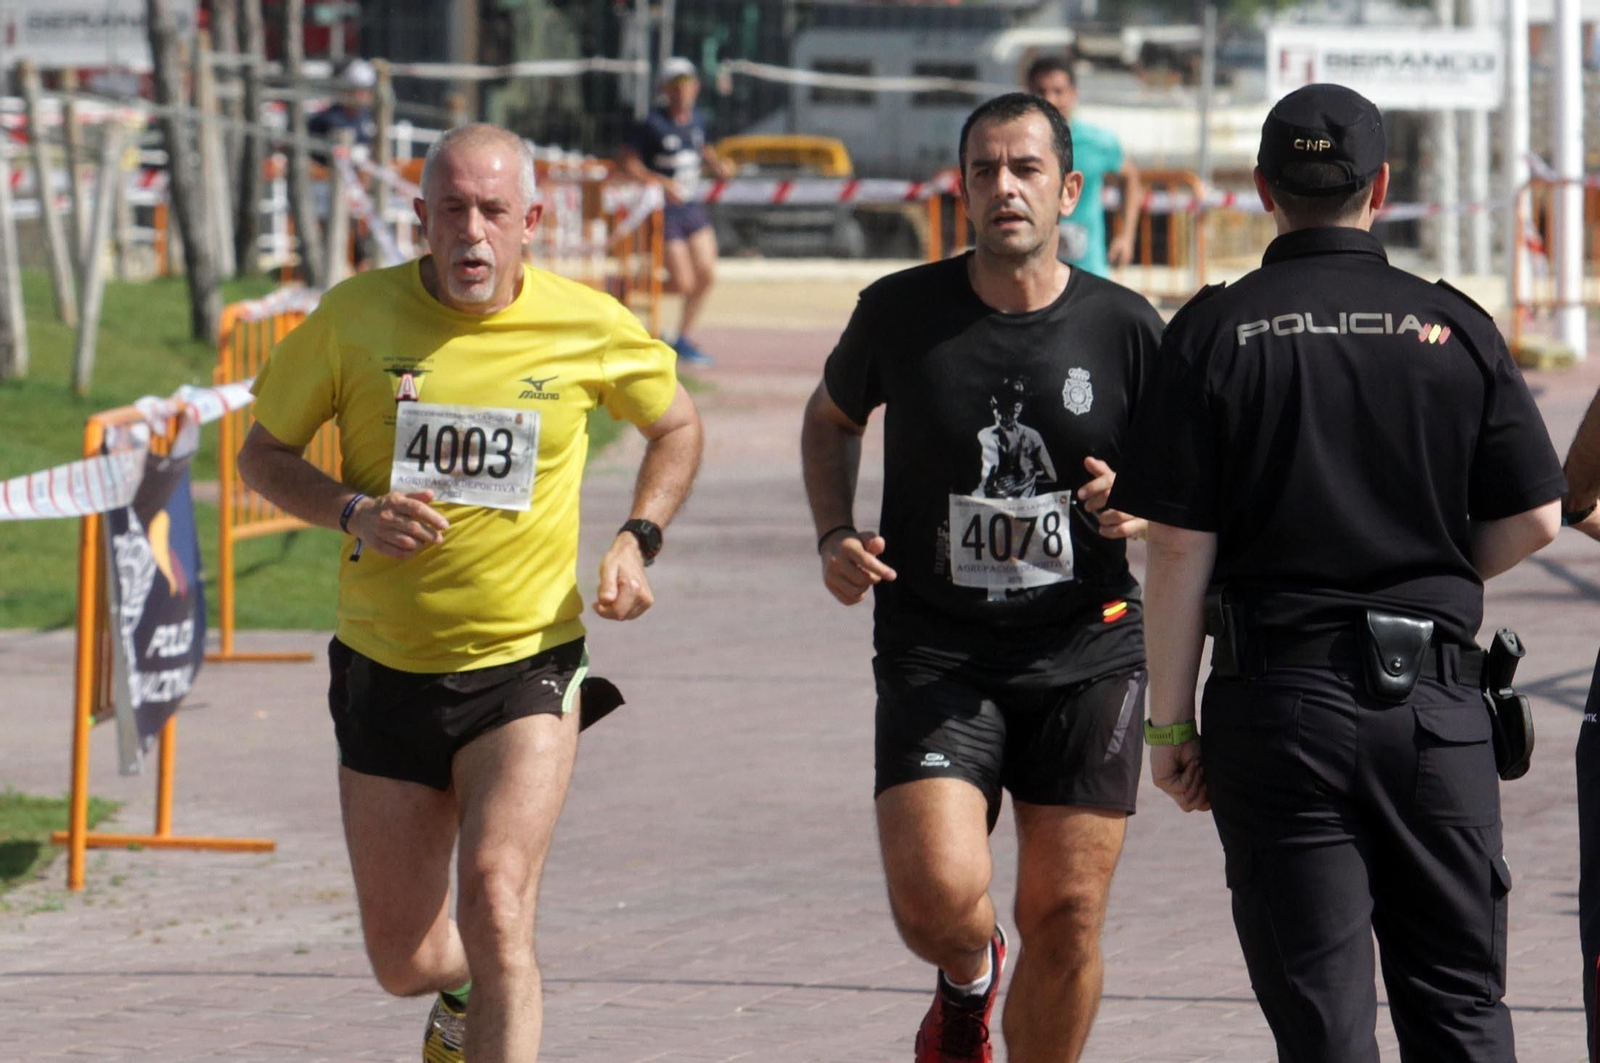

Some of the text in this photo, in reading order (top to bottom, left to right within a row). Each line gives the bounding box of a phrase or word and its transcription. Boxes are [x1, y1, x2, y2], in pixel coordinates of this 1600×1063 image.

[1293, 137, 1332, 152] CNP
[1236, 312, 1426, 346] POLICIA
[405, 422, 514, 480] 4003
[961, 510, 1063, 562] 4078
